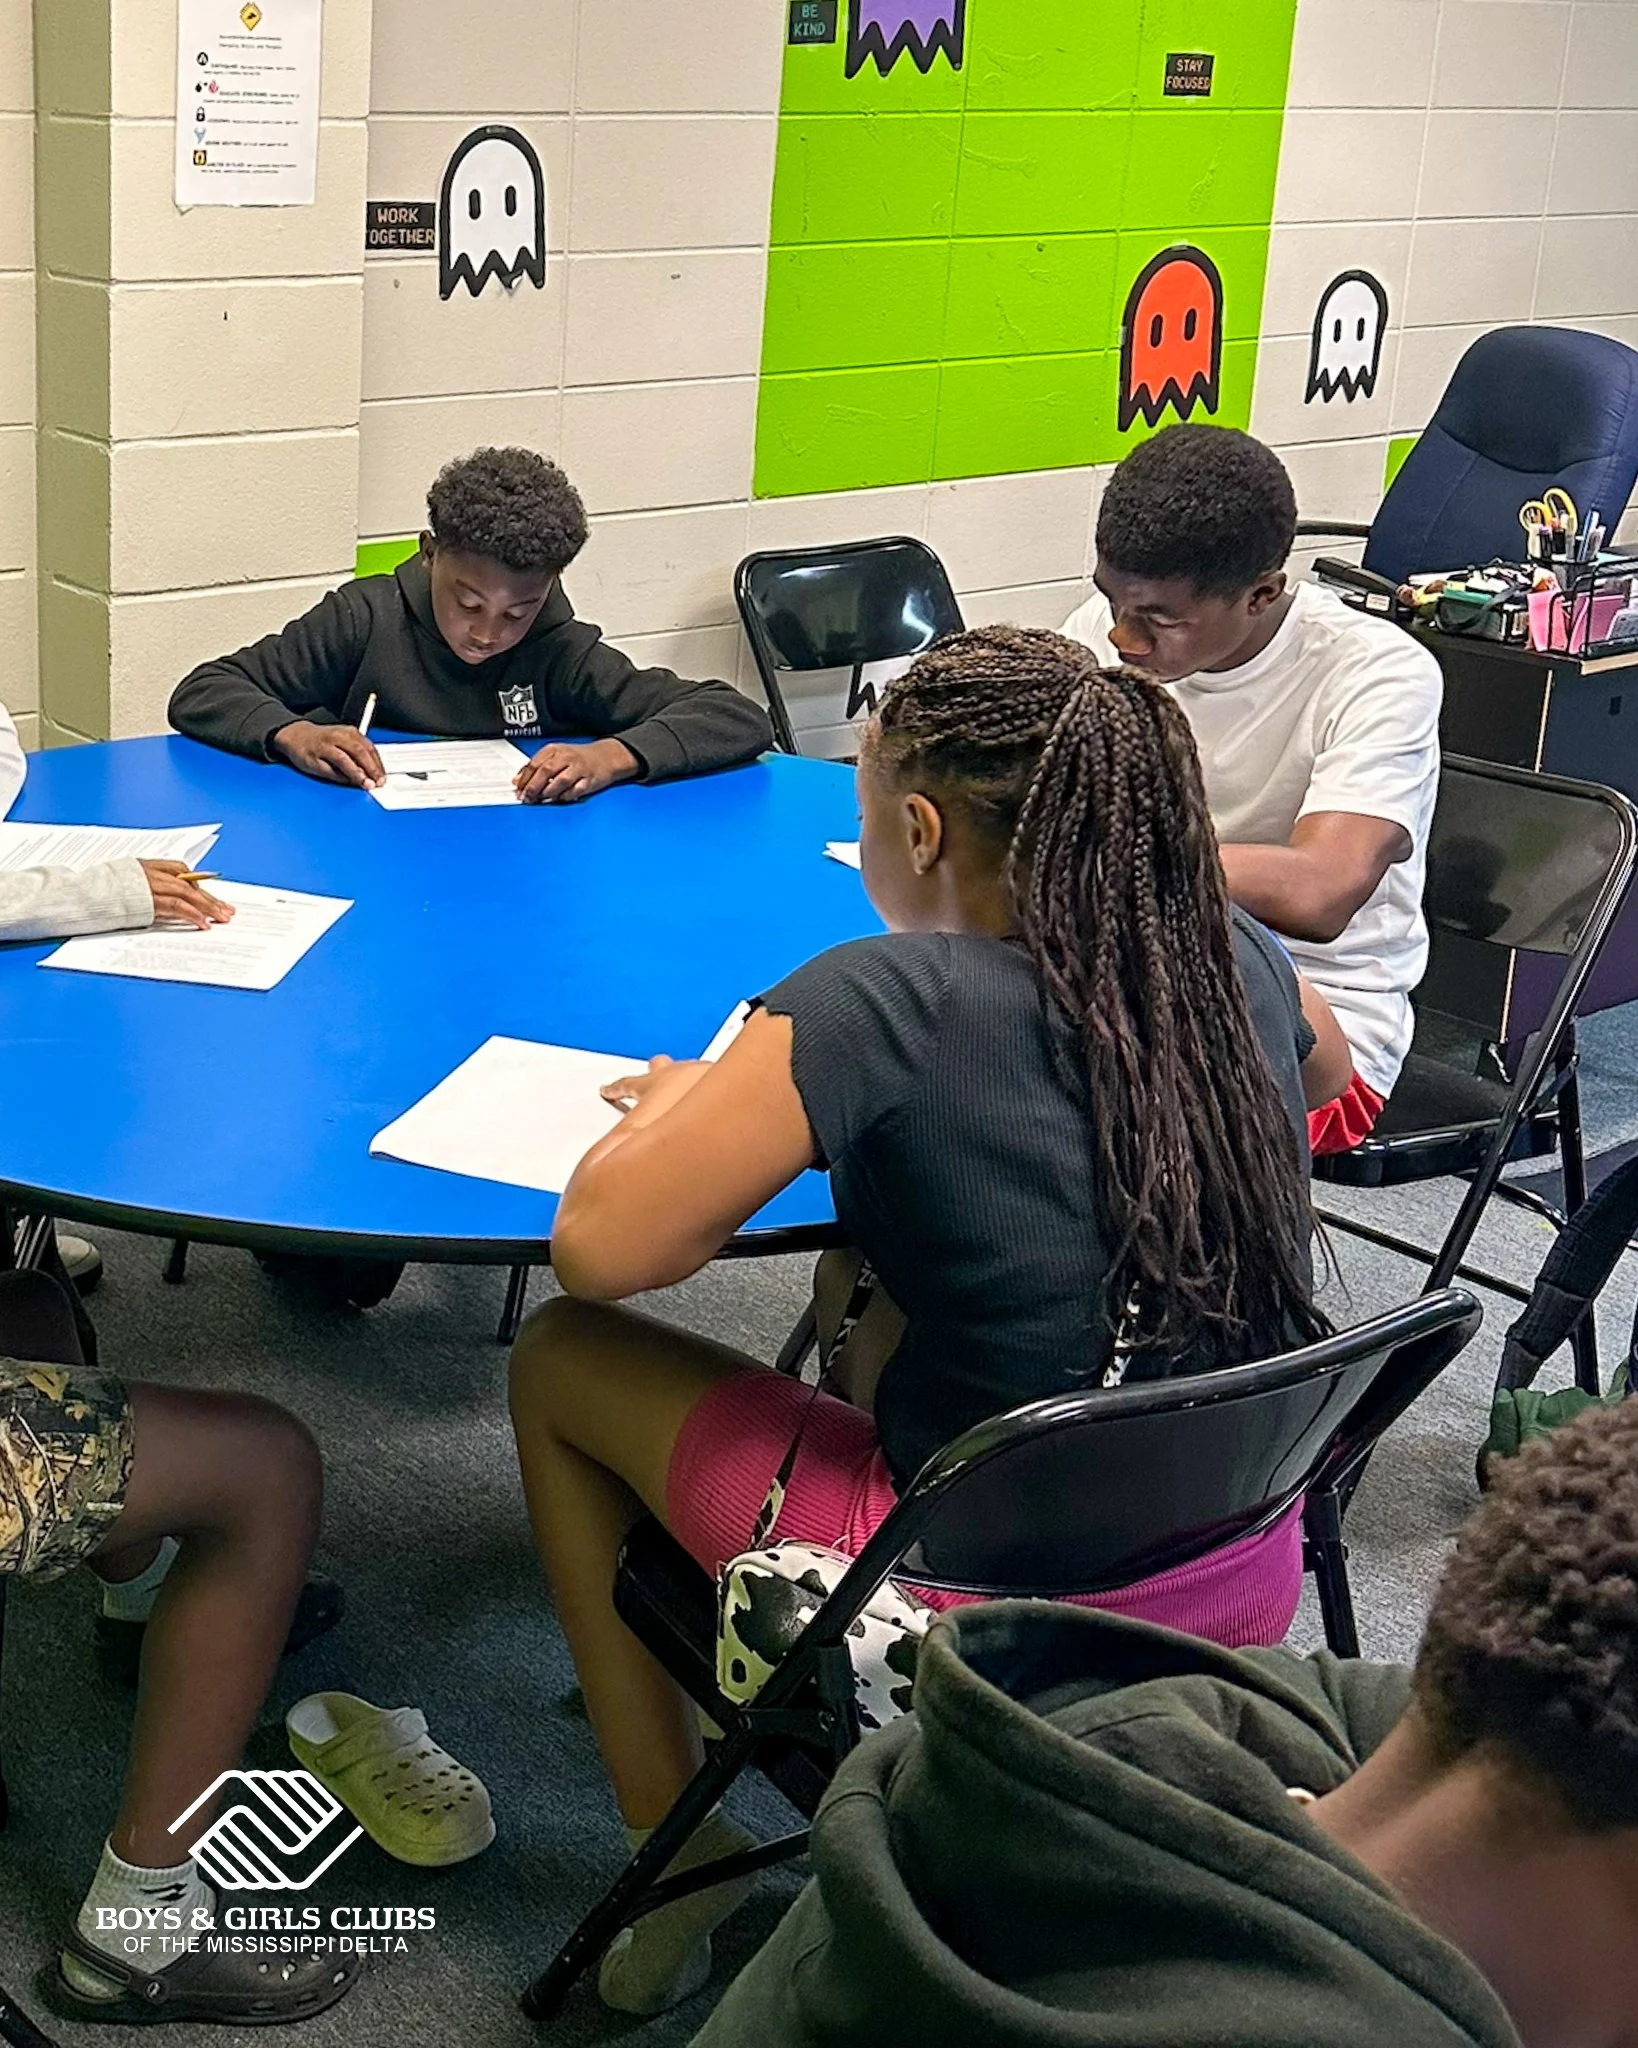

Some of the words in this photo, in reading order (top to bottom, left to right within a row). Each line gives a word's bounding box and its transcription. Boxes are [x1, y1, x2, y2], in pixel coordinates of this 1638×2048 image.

[801, 4, 819, 18] BE
[793, 22, 826, 36] KIND
[1176, 59, 1204, 72] STAY
[377, 207, 419, 224] WORK
[367, 228, 435, 245] OGETHER
[507, 702, 535, 722] NFL
